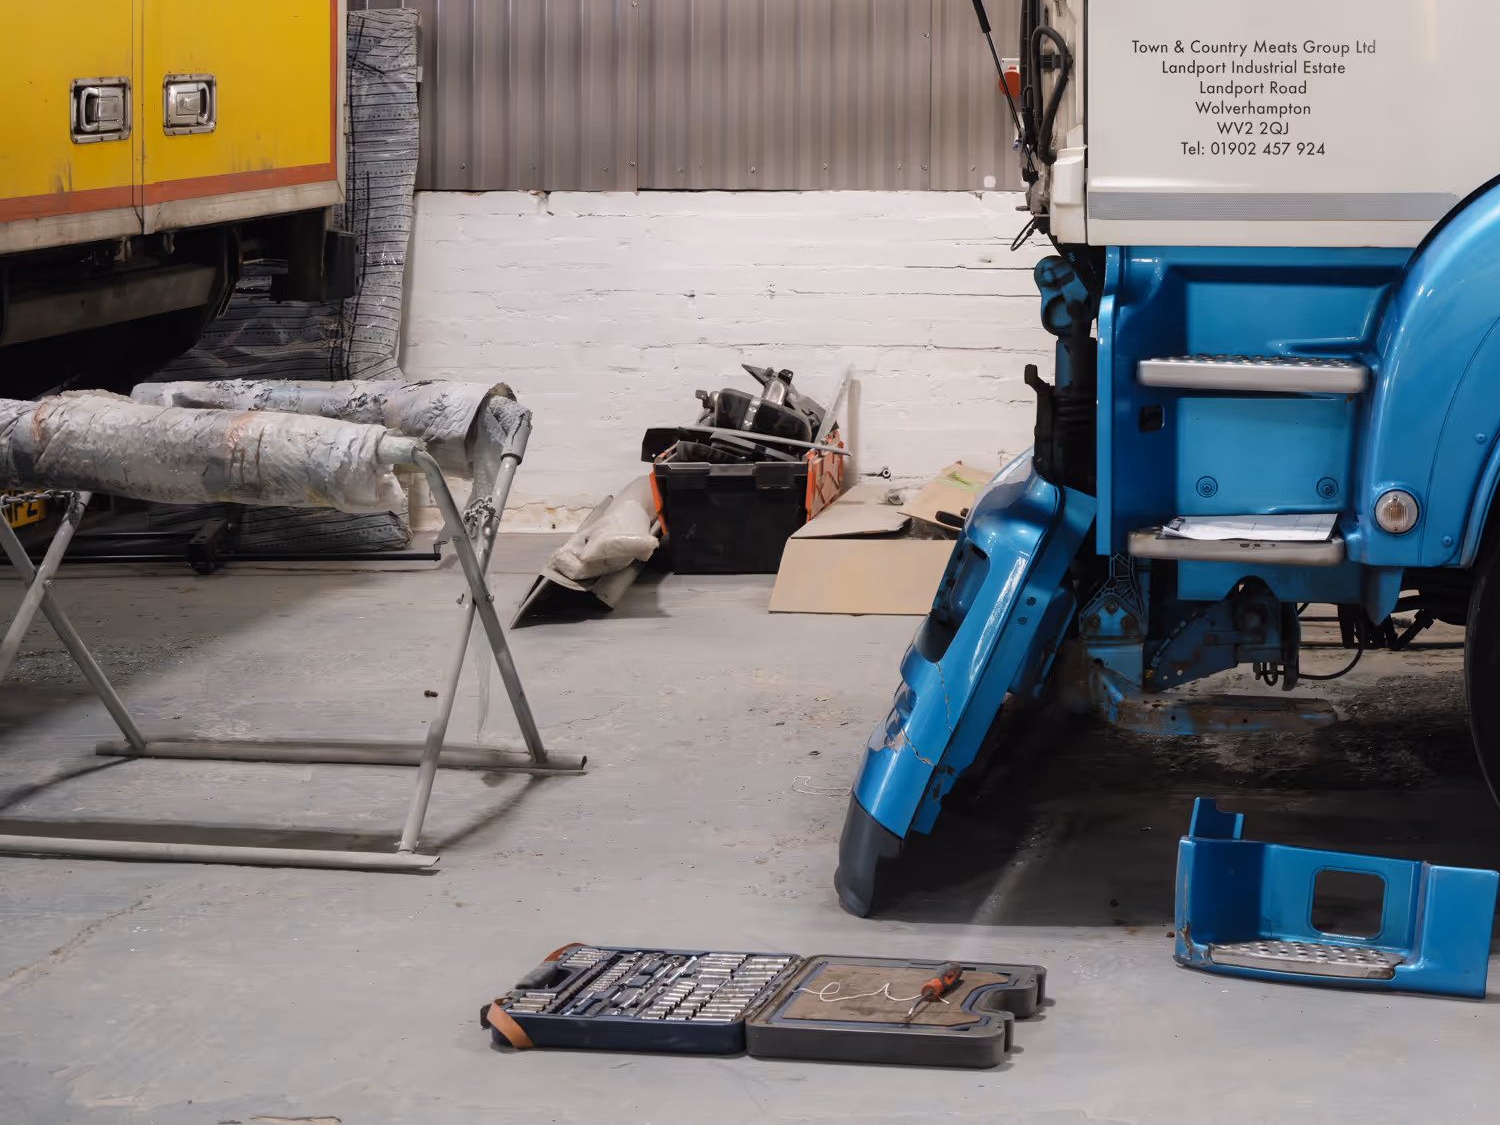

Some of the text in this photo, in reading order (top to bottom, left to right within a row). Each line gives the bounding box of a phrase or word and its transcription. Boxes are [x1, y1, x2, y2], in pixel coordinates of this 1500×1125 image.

[1132, 40, 1376, 57] Town & Country Meats Group Ltd
[1162, 60, 1346, 77] Landport Industrial Estate
[1199, 80, 1307, 98] Landport Road
[1195, 100, 1311, 118] Wolverhampton
[1217, 121, 1289, 136] WV2 2QJ
[1181, 141, 1326, 156] Tel: 01902 457 924
